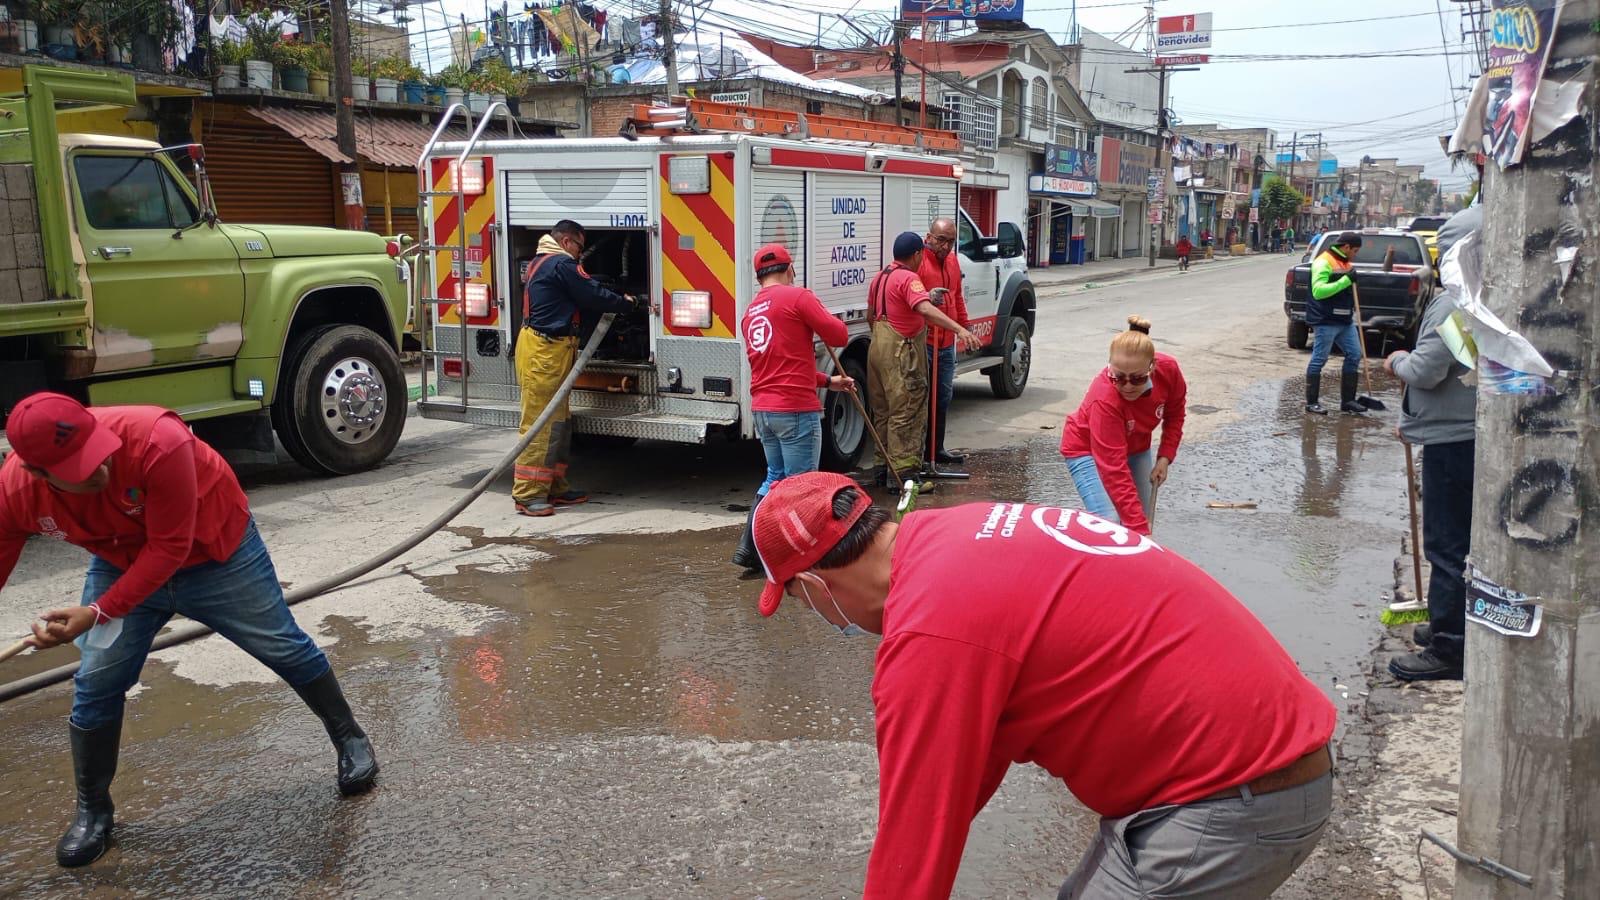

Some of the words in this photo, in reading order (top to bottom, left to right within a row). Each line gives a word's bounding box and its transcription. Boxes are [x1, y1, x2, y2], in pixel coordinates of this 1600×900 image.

[1158, 34, 1209, 46] benavides
[832, 197, 866, 214] UNIDAD
[610, 214, 644, 227] U-001
[843, 222, 856, 238] DE
[831, 245, 867, 263] ATAQUE
[832, 268, 866, 287] LIGERO
